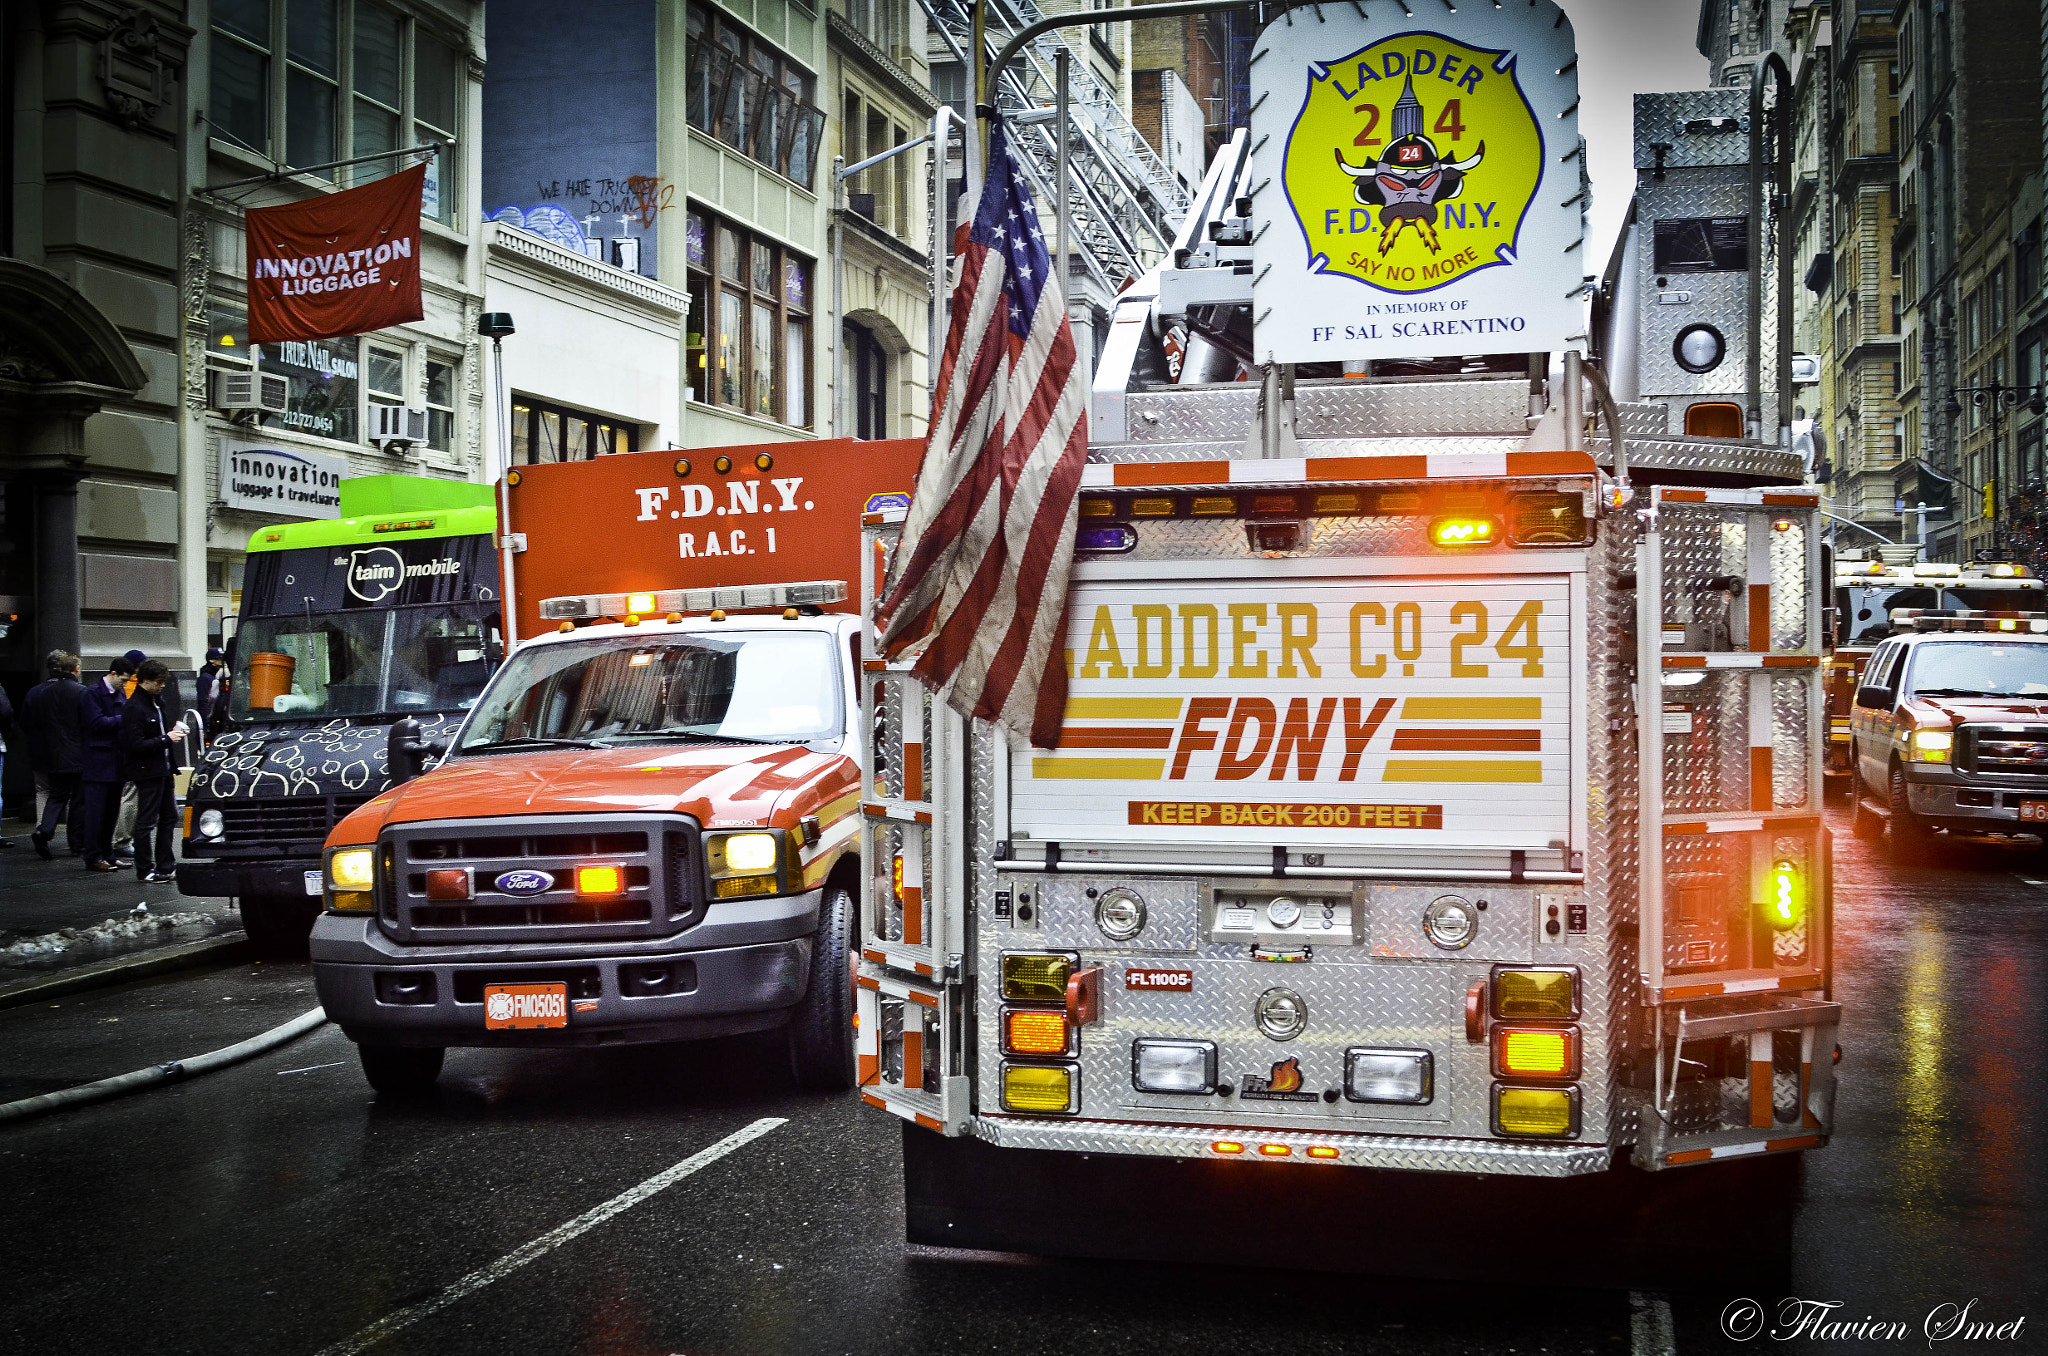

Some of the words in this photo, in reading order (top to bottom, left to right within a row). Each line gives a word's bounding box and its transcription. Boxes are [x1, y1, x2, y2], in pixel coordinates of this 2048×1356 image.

[1332, 49, 1484, 101] LADDER
[1353, 103, 1382, 147] 2
[1433, 98, 1466, 142] 4
[1402, 147, 1420, 160] 24
[537, 180, 560, 200] WE
[566, 179, 592, 198] HATE
[590, 197, 636, 214] DOWN
[1325, 208, 1378, 235] F.D.
[1444, 202, 1500, 230] N.Y.
[255, 237, 412, 279] INNOVATION
[1346, 251, 1383, 276] SAY
[1386, 265, 1415, 282] NO
[1422, 246, 1479, 281] MORE
[282, 267, 381, 296] LUGGAGE
[1366, 305, 1381, 316] IN
[1384, 301, 1447, 315] MEMORY
[1450, 300, 1469, 310] OF
[1312, 326, 1336, 342] FF
[1345, 324, 1383, 340] SAL
[1392, 316, 1525, 338] SCARENTINO
[280, 341, 307, 368] TRUE
[331, 357, 358, 379] SALON
[231, 450, 340, 488] innovation
[232, 478, 274, 500] luggage
[277, 484, 284, 499] &
[288, 487, 341, 507] travelware
[635, 476, 815, 522] F.D.N.Y.
[678, 529, 755, 559] R.A.C.
[765, 527, 776, 553] 1
[333, 556, 349, 566] the
[406, 557, 461, 577] mobile
[1450, 600, 1544, 678] 24
[1168, 697, 1398, 781] FDNY
[1142, 803, 1212, 824] KEEP
[1220, 804, 1295, 825] BACK
[1302, 805, 1351, 826] 200
[1359, 806, 1428, 827] FEET
[2036, 804, 2048, 819] 6
[506, 874, 540, 890] Ford
[1130, 972, 1188, 986] FL11005
[514, 993, 566, 1018] FM05051
